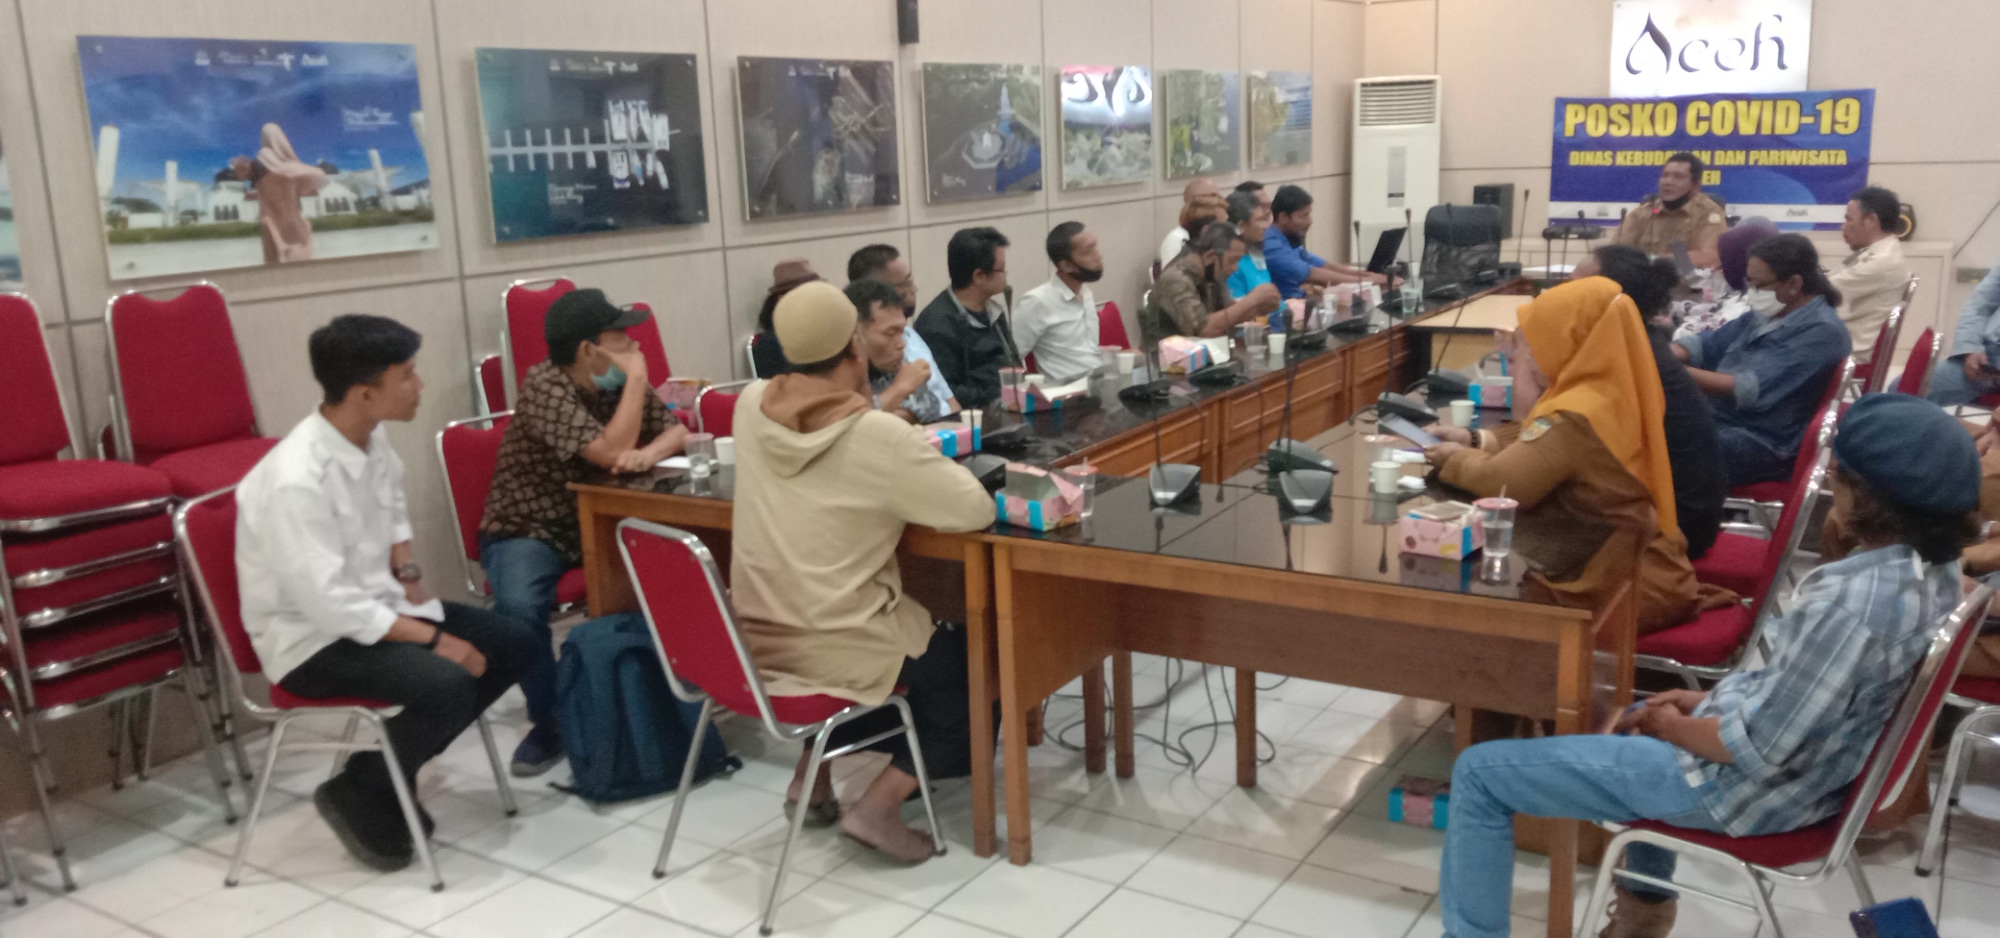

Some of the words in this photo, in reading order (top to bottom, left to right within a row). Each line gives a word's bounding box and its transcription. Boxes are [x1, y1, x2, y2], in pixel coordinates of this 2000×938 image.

[1625, 12, 1788, 75] Aceh
[1563, 102, 1678, 138] POSKO
[1685, 97, 1862, 137] COVID-19
[1568, 150, 1613, 167] DINAS
[1615, 150, 1712, 167] KEBUDAN
[1714, 150, 1747, 166] DAN
[1749, 149, 1848, 166] PARIWISATA
[1702, 169, 1722, 186] EH
